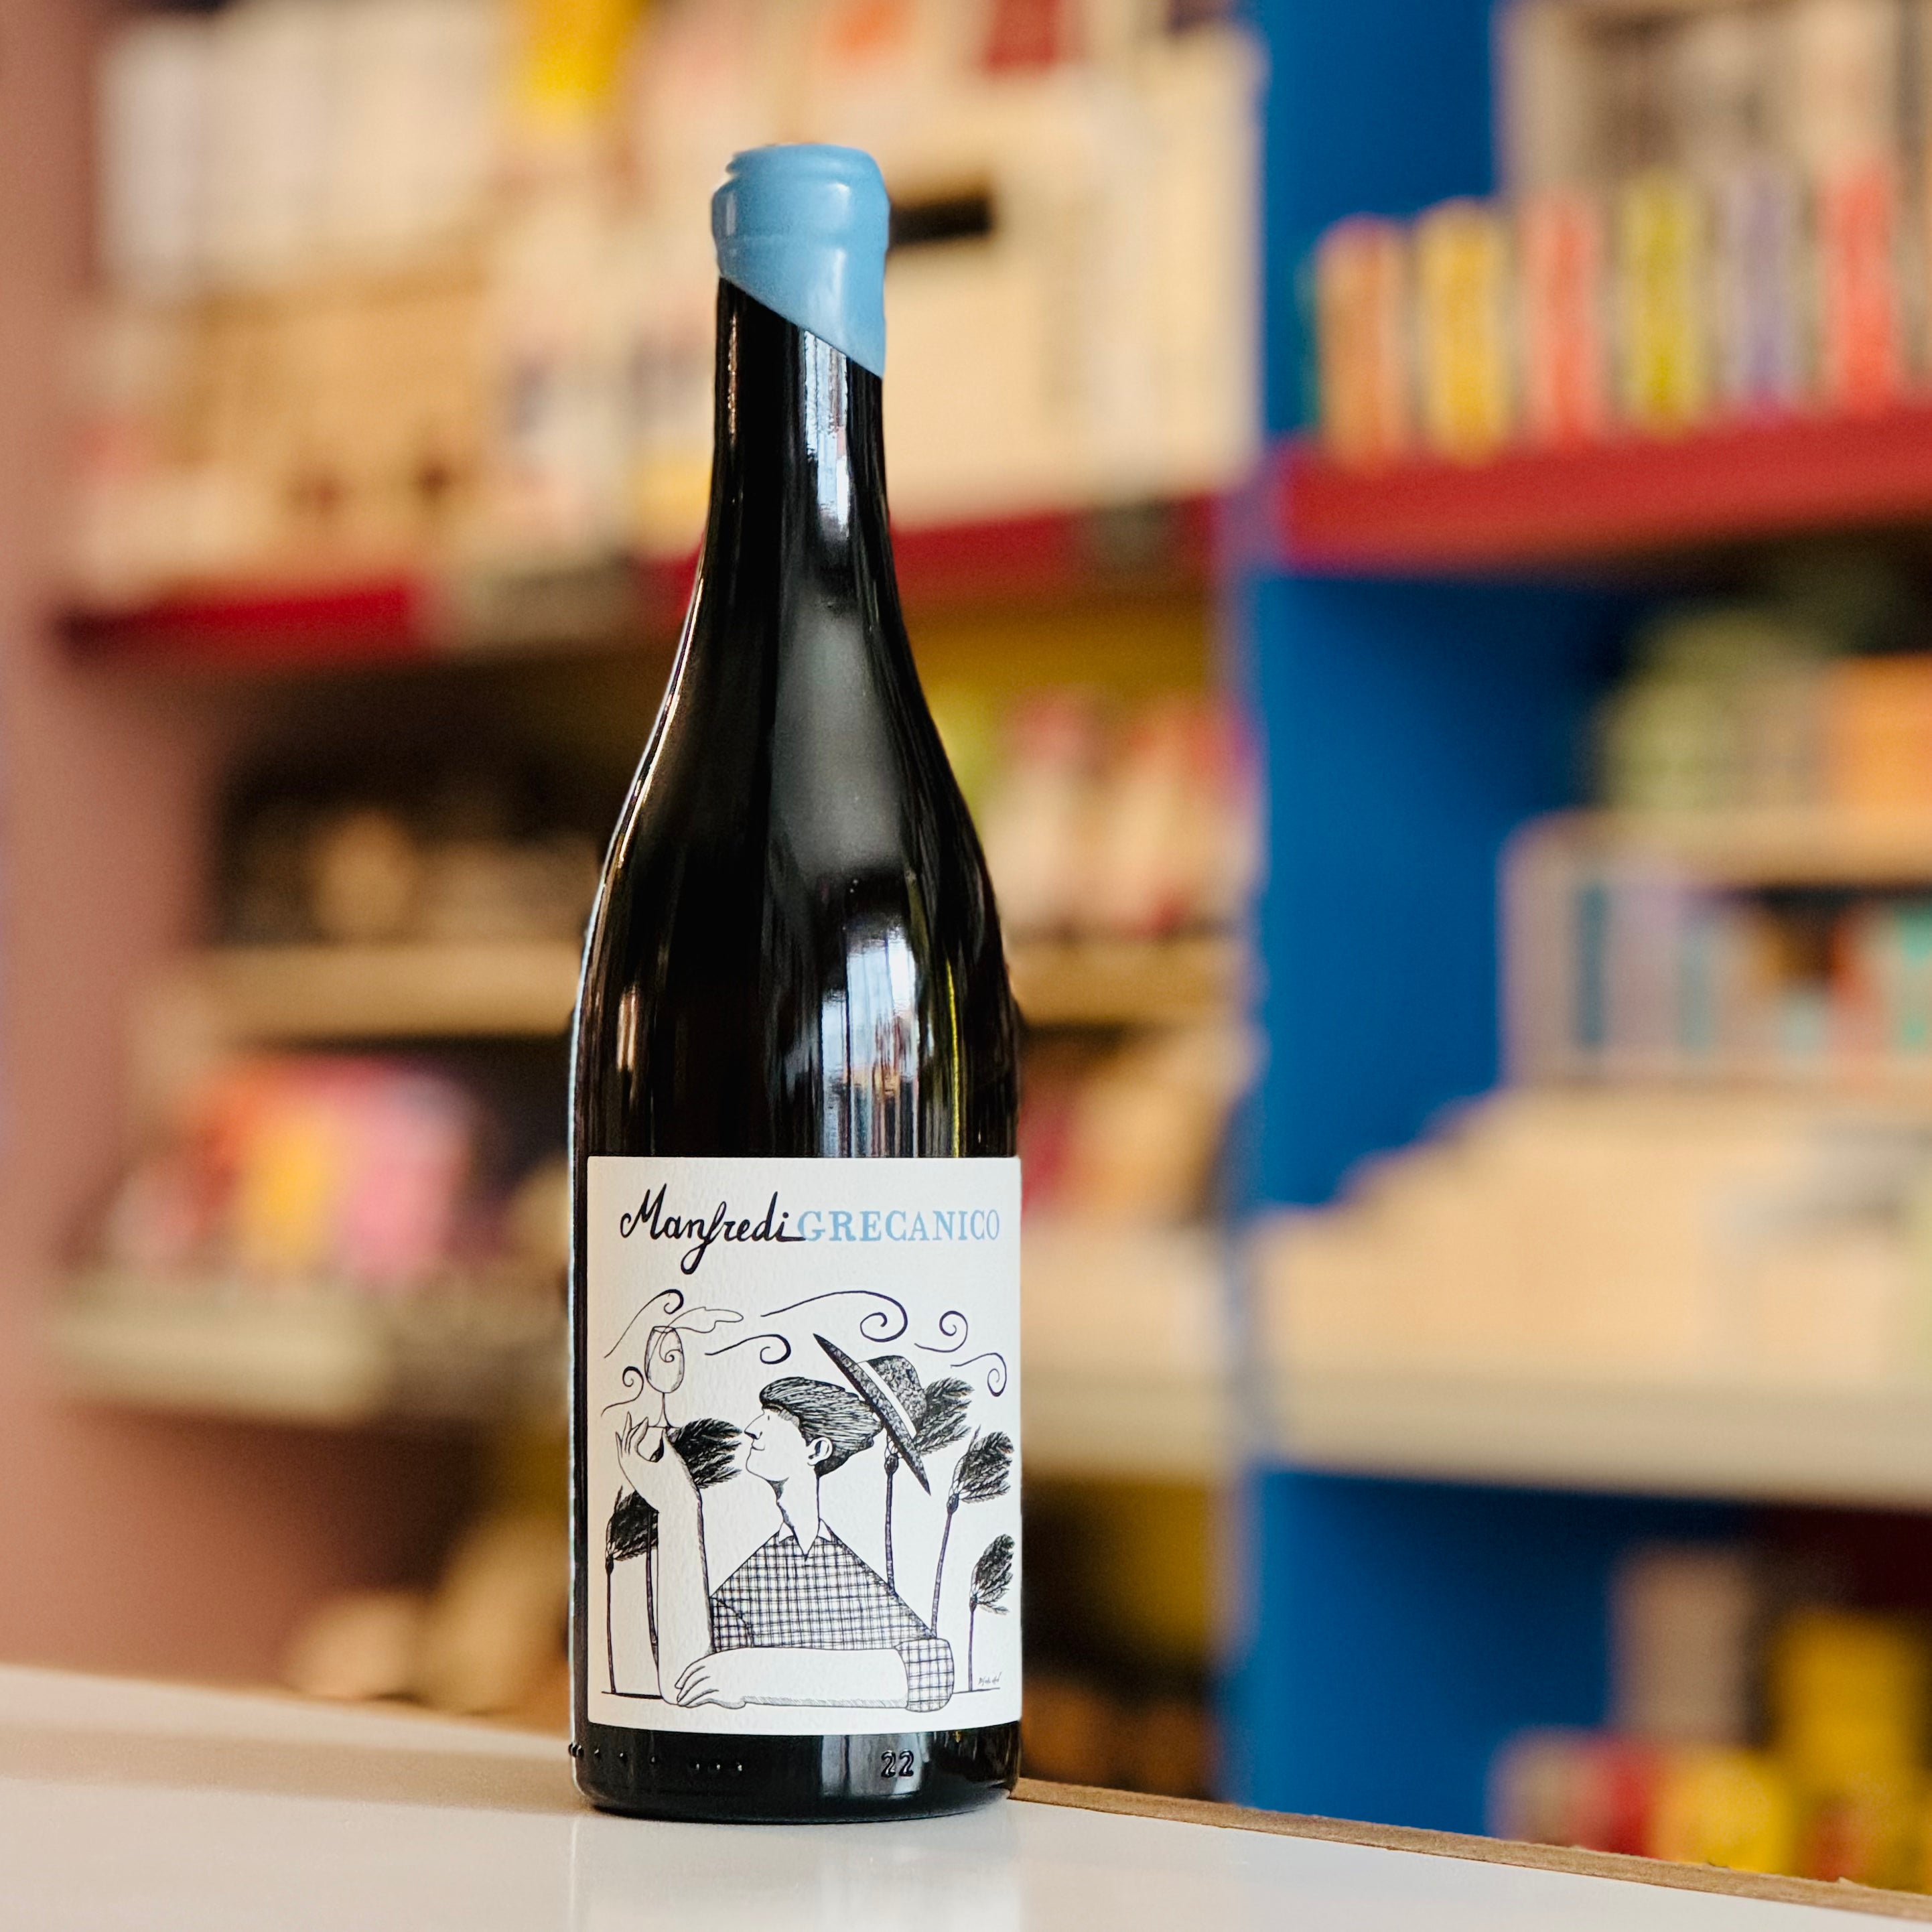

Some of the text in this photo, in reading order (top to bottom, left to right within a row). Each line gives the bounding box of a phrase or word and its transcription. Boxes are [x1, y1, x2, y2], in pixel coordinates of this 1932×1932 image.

[620, 1183, 1000, 1275] Manfredi GRECANICO
[881, 1749, 914, 1778] 22
